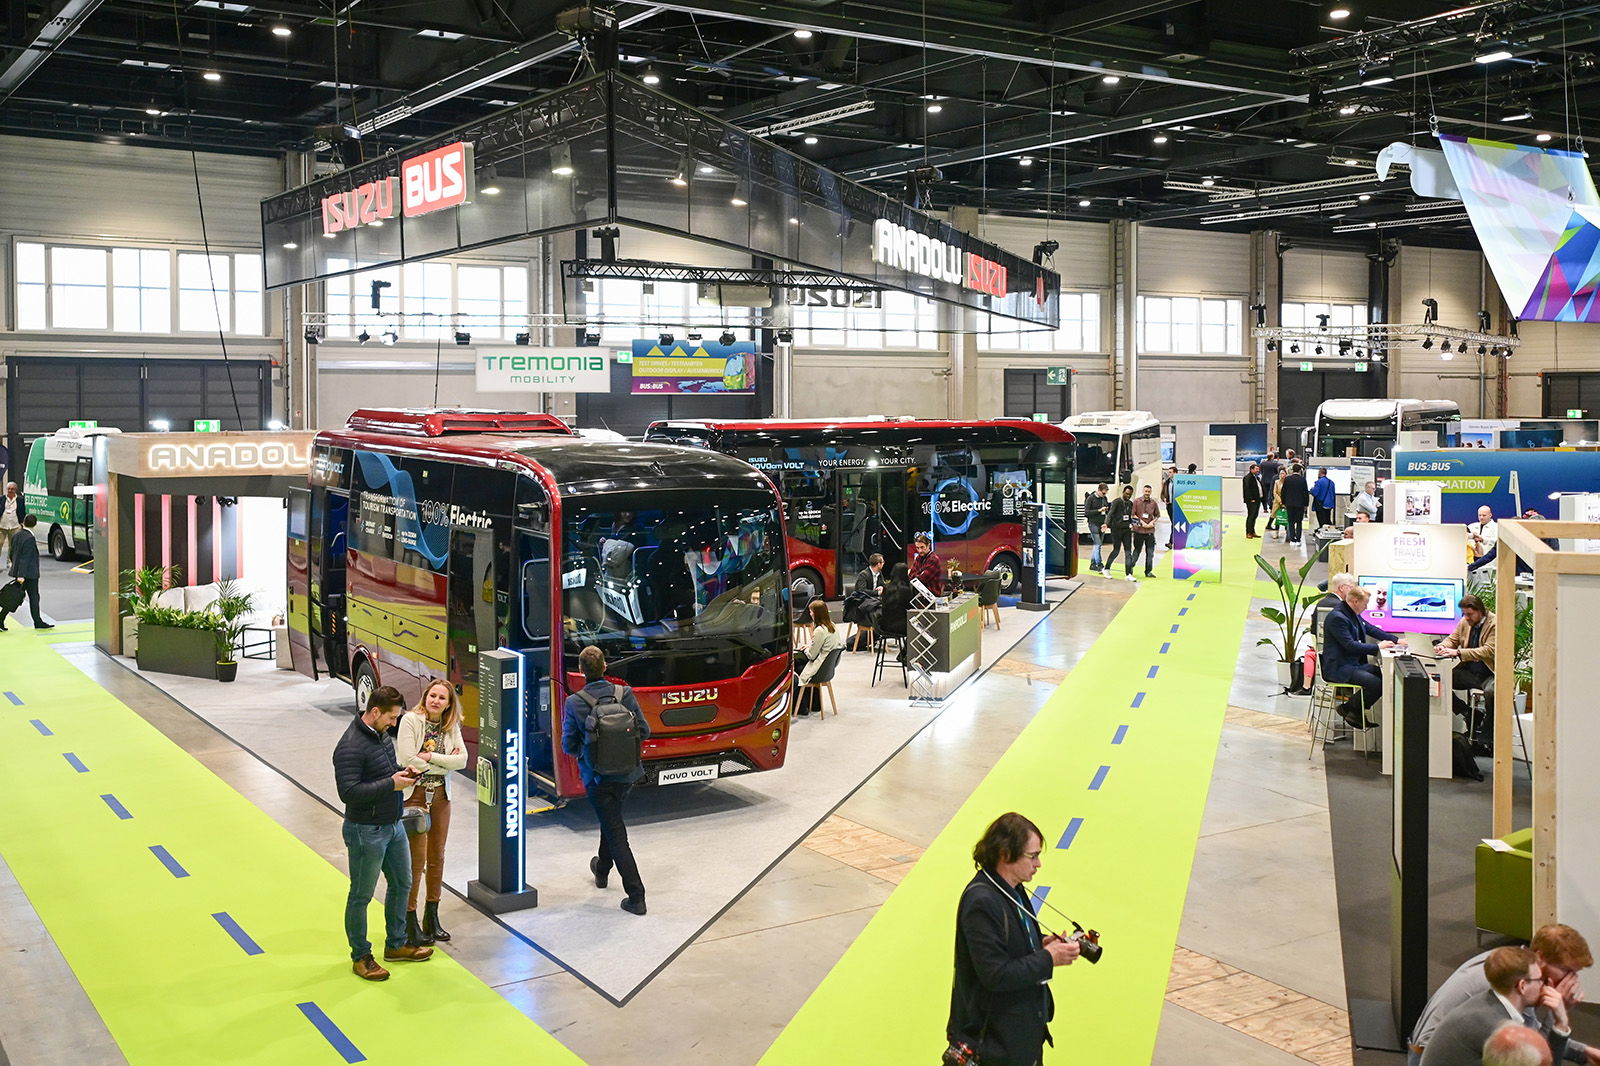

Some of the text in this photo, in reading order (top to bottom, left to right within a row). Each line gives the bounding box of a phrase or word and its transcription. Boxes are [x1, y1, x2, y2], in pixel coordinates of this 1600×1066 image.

[321, 151, 463, 235] ISUZU BUS
[873, 218, 1008, 299] ANADOLU ISUZU
[150, 445, 310, 469] ANADOL
[818, 459, 838, 468] YOUR
[880, 457, 900, 466] YOUR
[783, 462, 804, 470] VOLT
[1408, 462, 1451, 471] BUS2BUS
[1441, 480, 1485, 490] MATION
[922, 501, 950, 515] 100%
[951, 498, 991, 513] Electric
[421, 500, 492, 528] 100% Electric
[1393, 536, 1426, 546] FRESH
[1393, 547, 1427, 557] TRAVEL
[661, 688, 718, 705] ISUZU
[663, 769, 715, 781] NOVO VOLT
[505, 729, 519, 837] NOVO VOLT
